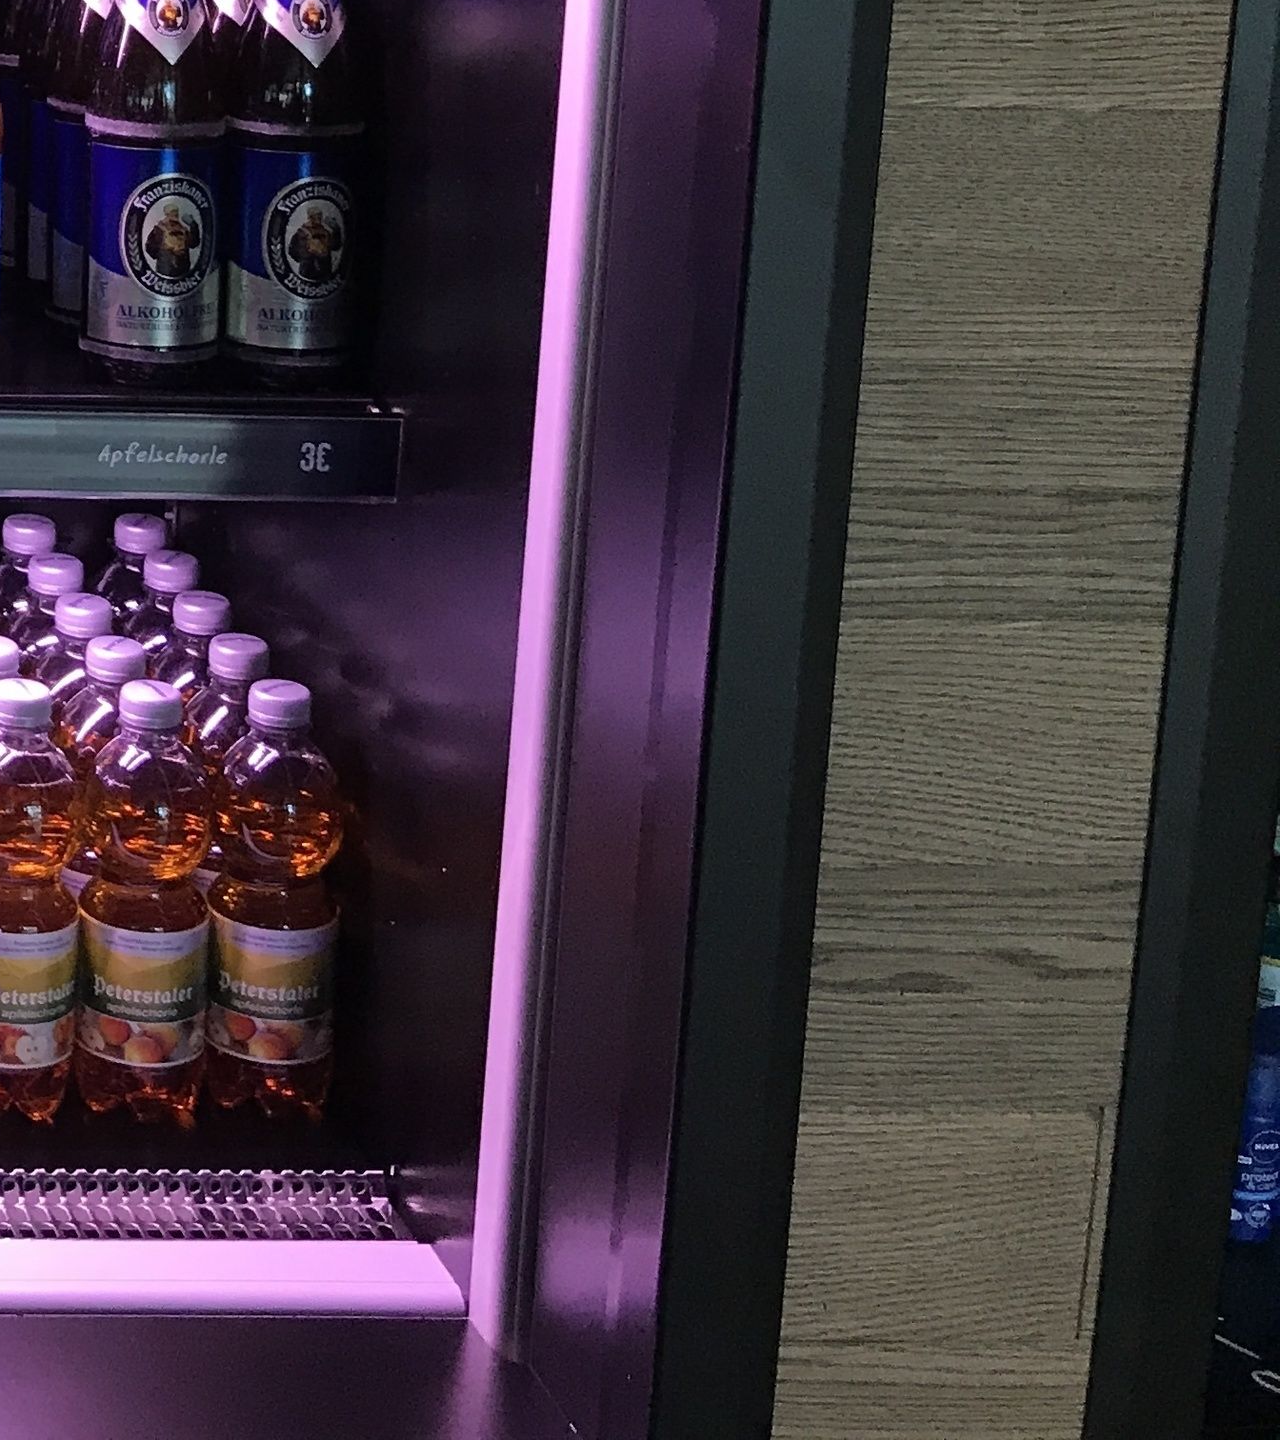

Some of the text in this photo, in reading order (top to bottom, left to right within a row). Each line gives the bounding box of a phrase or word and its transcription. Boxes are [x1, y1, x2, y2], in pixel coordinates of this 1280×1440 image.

[134, 180, 209, 213] Franziskaner
[141, 270, 202, 297] Weissbier
[97, 441, 228, 468] Apfelschorle
[299, 442, 332, 472] 3€
